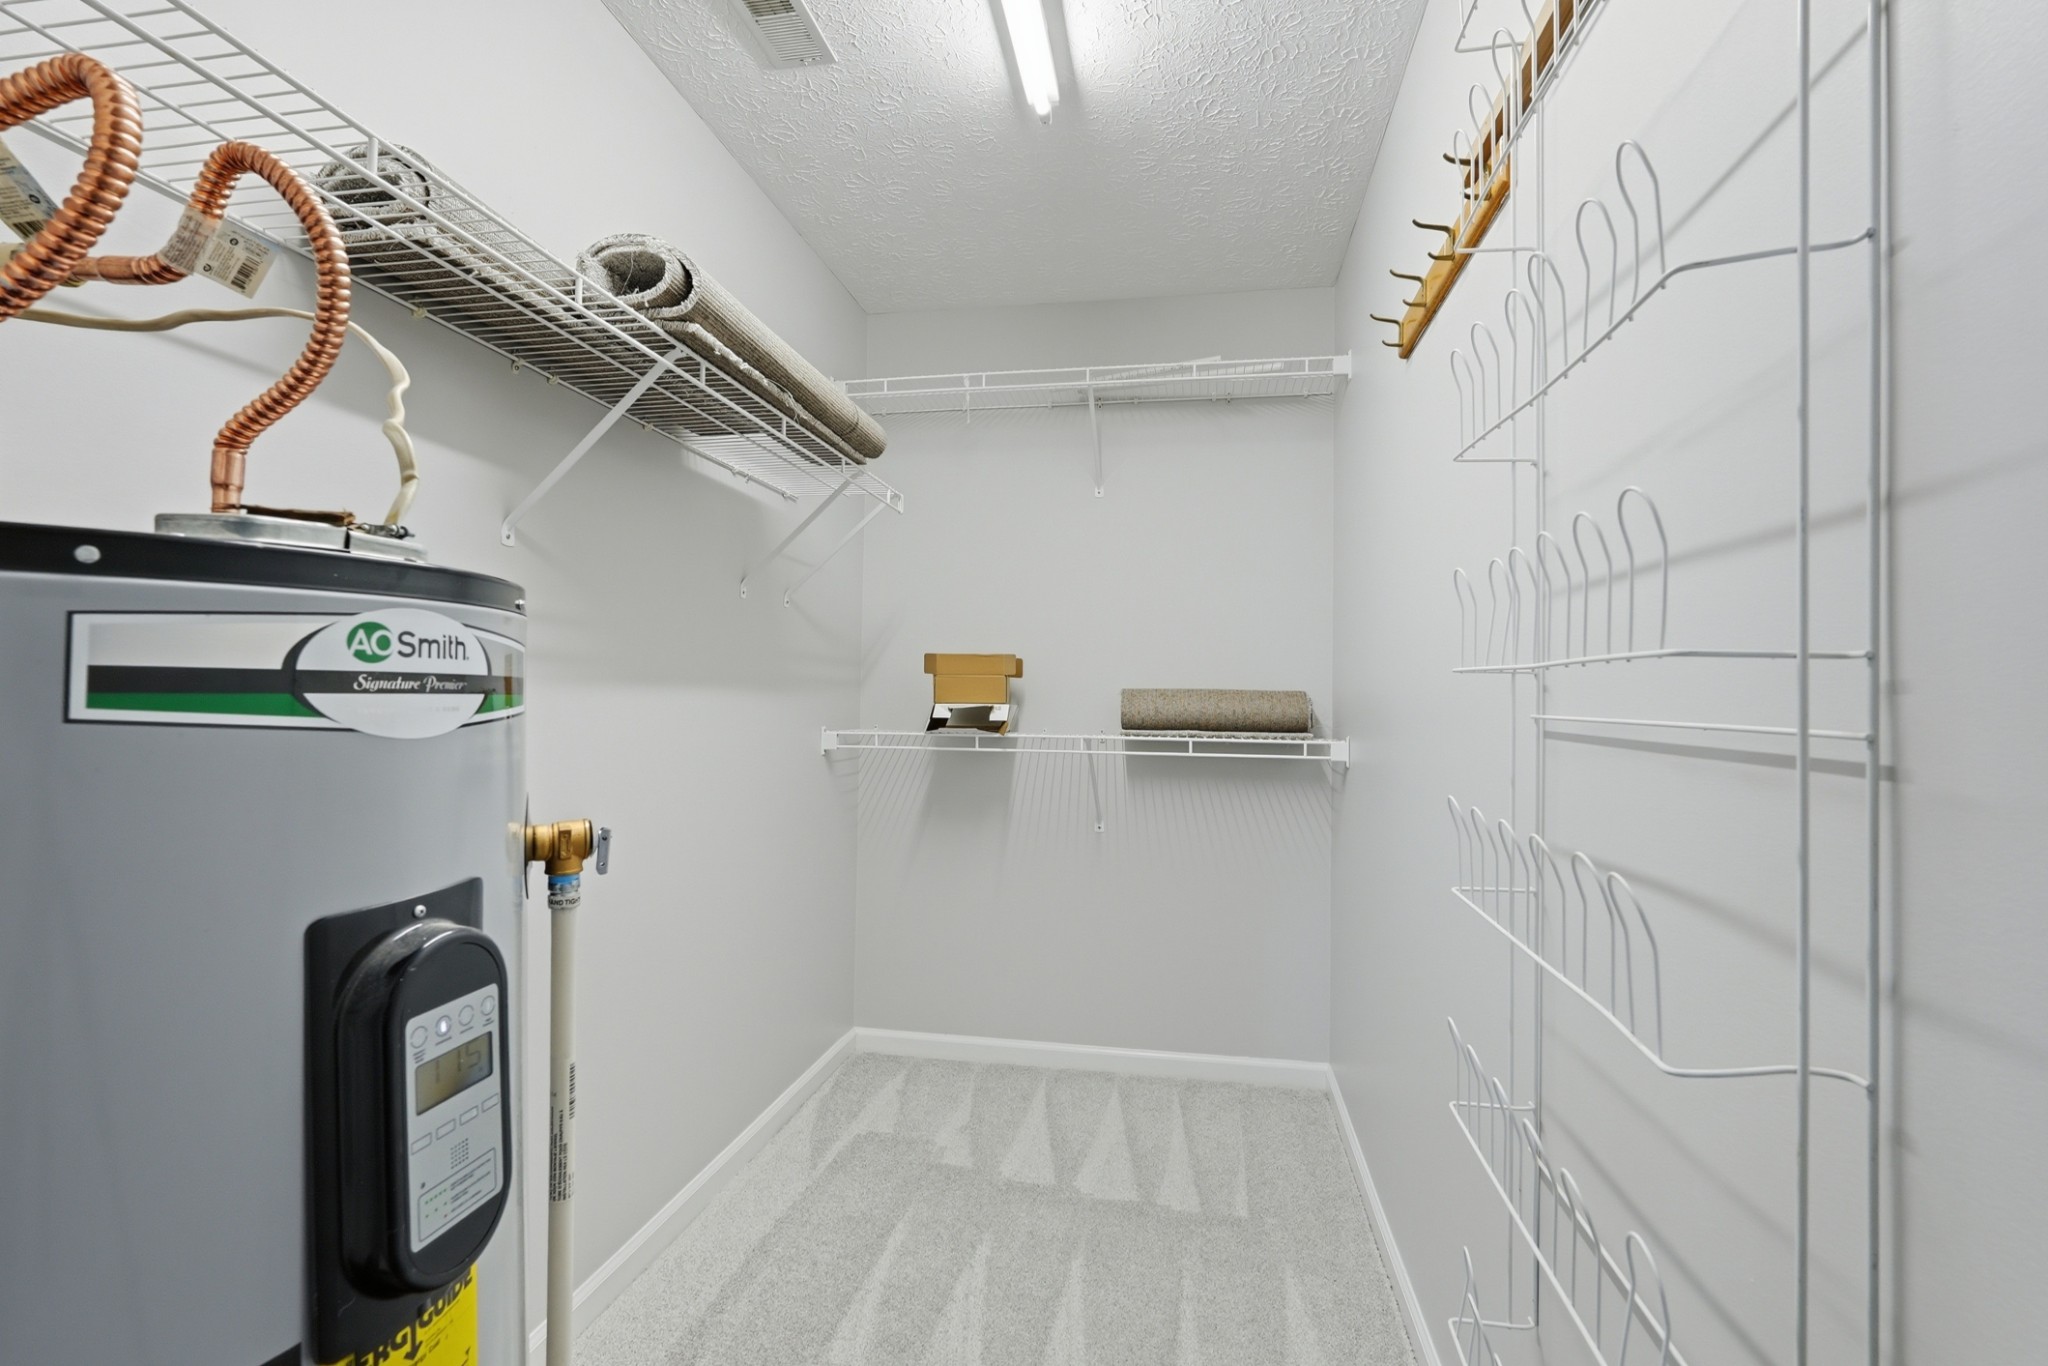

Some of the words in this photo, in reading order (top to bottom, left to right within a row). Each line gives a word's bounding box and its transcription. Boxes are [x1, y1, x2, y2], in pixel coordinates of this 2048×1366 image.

[351, 626, 394, 658] AO
[397, 631, 467, 661] Smith
[353, 673, 421, 692] Signature
[422, 675, 466, 692] Premier
